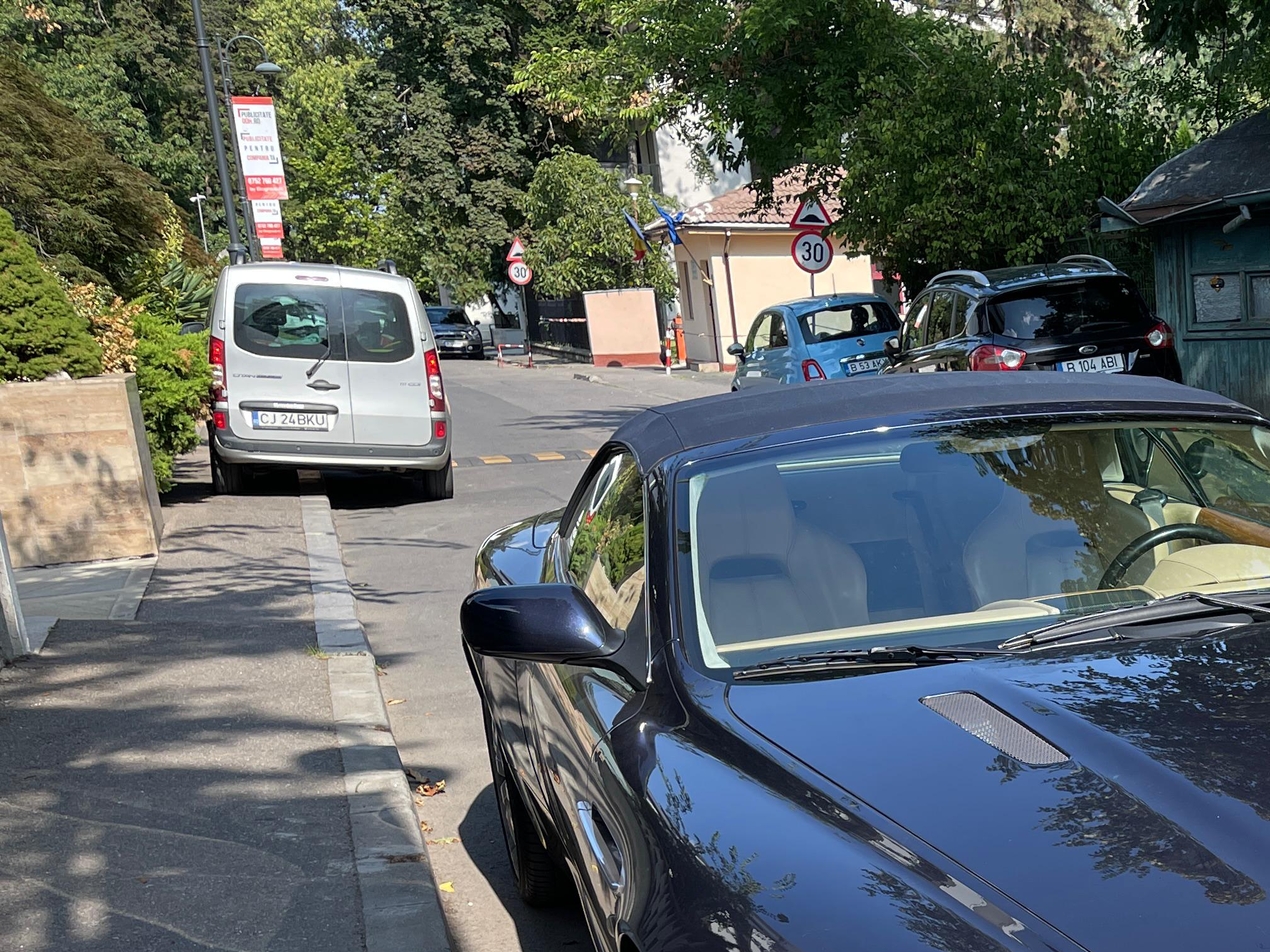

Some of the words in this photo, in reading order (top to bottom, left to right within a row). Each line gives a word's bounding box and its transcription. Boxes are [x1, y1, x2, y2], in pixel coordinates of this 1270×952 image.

[802, 241, 824, 263] 30
[514, 266, 527, 278] 30
[850, 363, 857, 372] B
[859, 361, 870, 370] 53
[1066, 362, 1076, 372] B
[1078, 359, 1096, 372] 104
[1101, 356, 1118, 369] ABI
[260, 413, 277, 425] CJ
